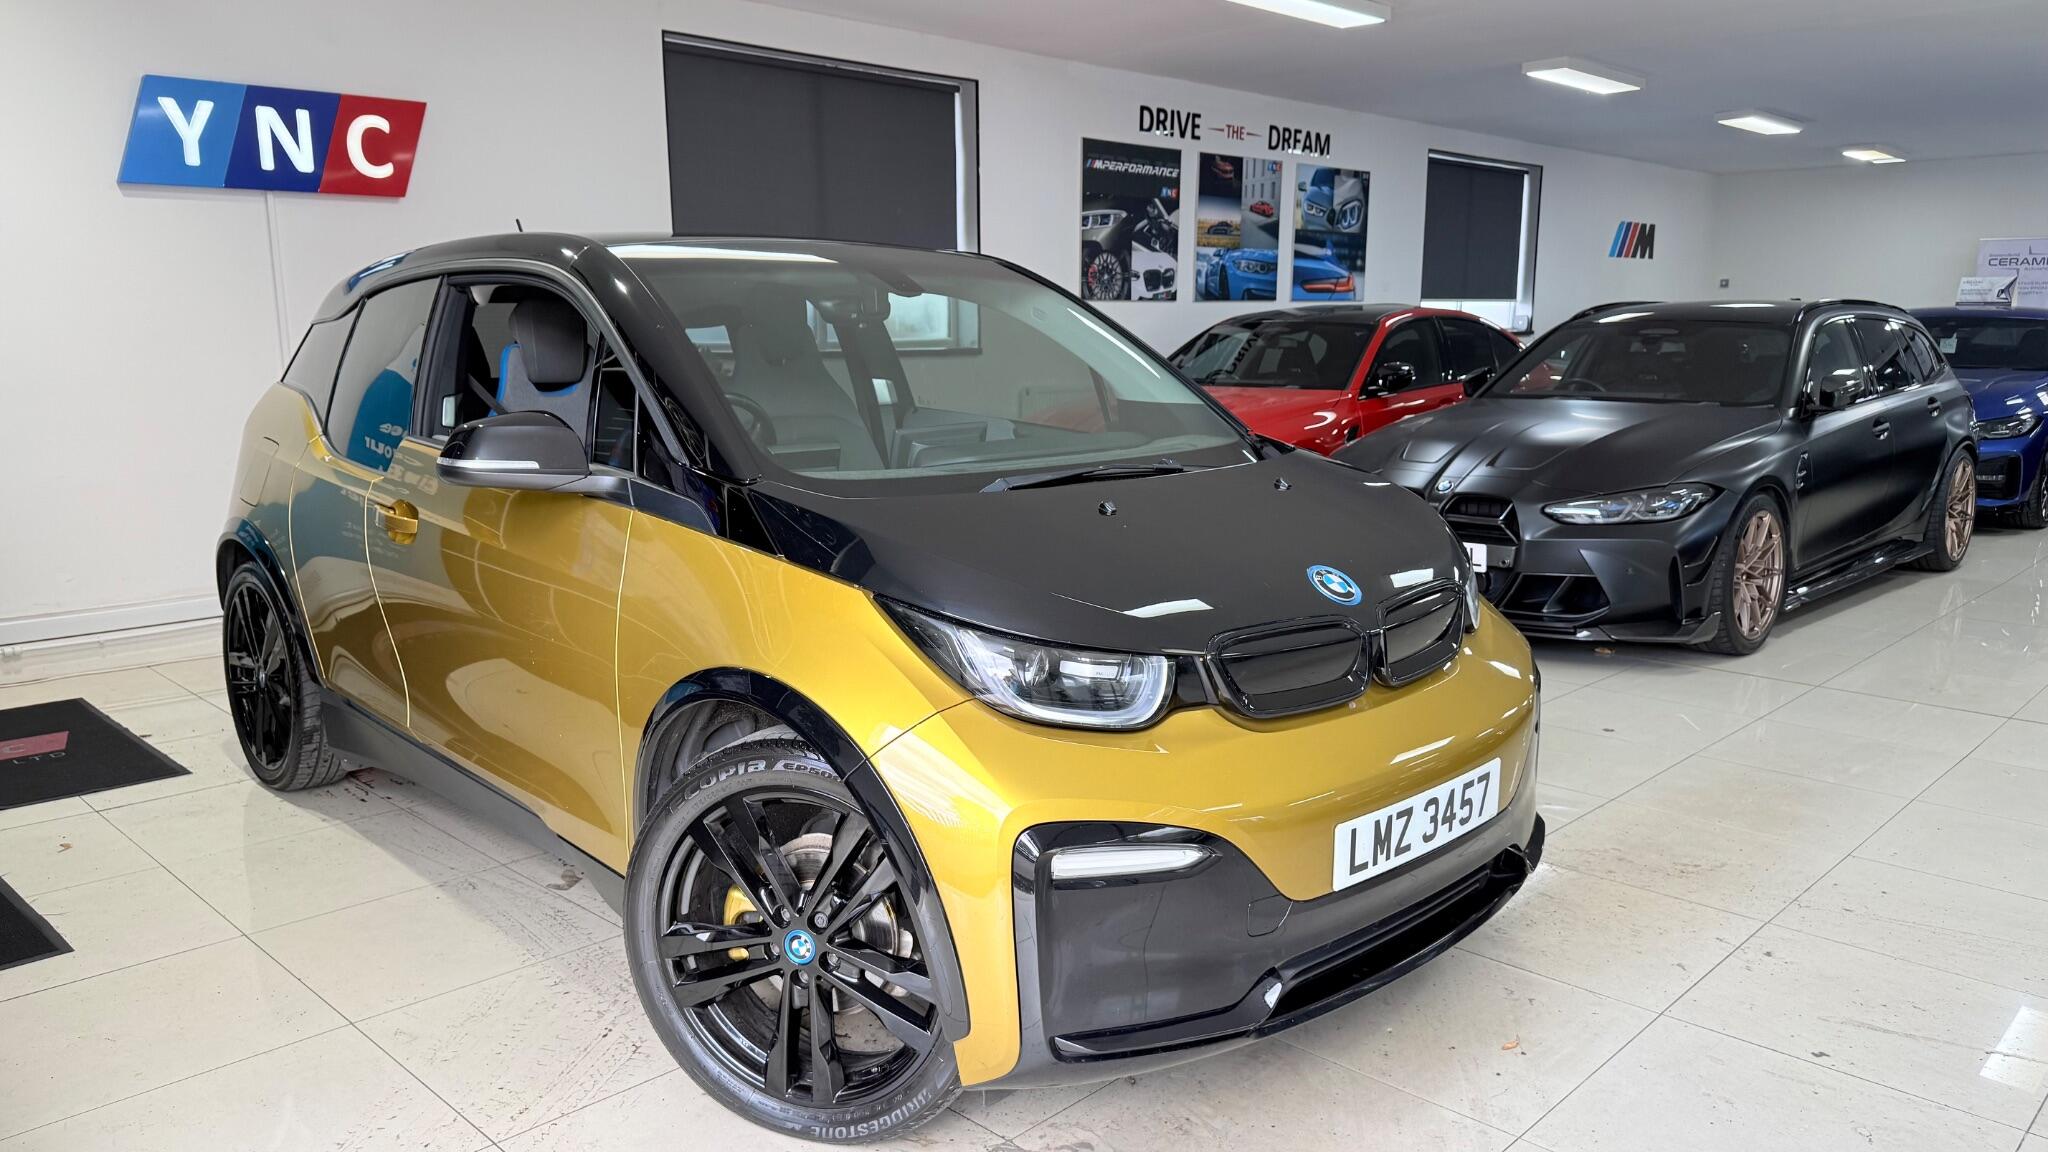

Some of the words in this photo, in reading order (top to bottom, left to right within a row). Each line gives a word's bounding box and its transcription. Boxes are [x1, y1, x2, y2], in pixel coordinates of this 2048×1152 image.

[157, 96, 394, 179] YNC
[1139, 105, 1201, 140] DRIVE
[1225, 124, 1245, 140] THE
[1268, 125, 1331, 156] DREAM
[12, 751, 66, 765] LTD
[1349, 806, 1414, 876] LMZ
[1422, 771, 1491, 844] 3457
